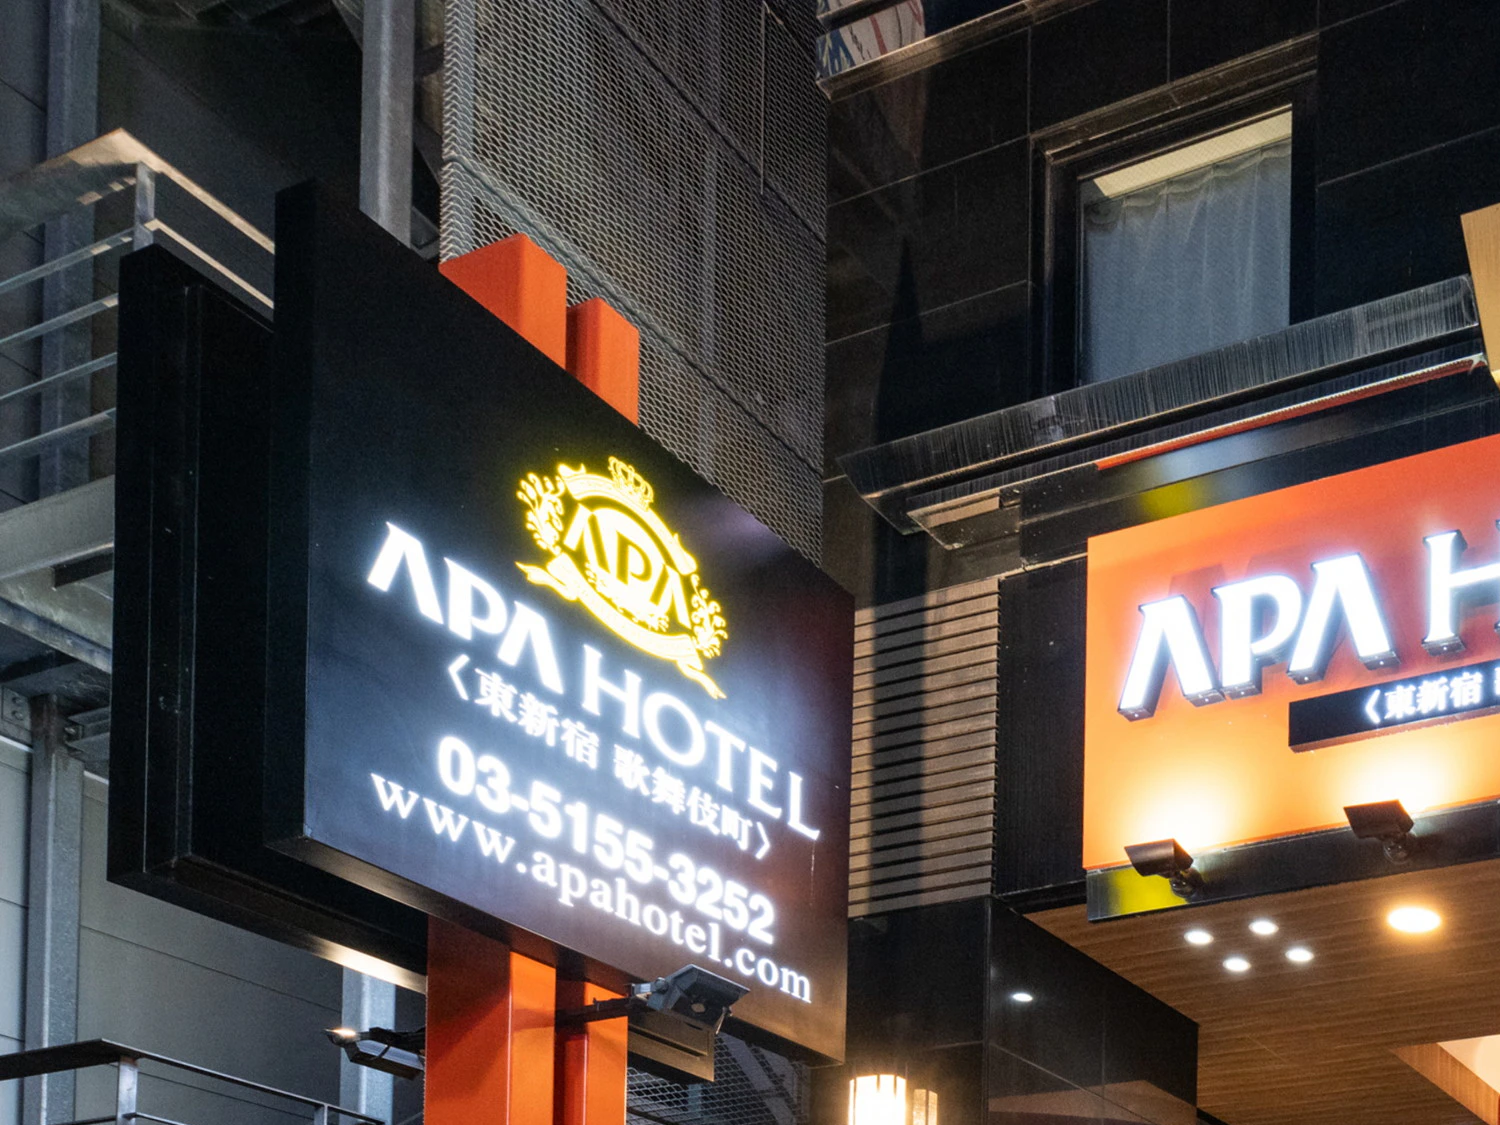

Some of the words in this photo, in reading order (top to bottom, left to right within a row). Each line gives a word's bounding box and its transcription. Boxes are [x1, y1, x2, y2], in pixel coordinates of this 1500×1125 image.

[563, 503, 693, 631] APA
[1117, 552, 1396, 720] APA
[366, 520, 565, 695] APA
[581, 643, 821, 841] HOTEL
[369, 772, 813, 1004] www.apahotel.com
[436, 735, 777, 946] 03-5155-3252
